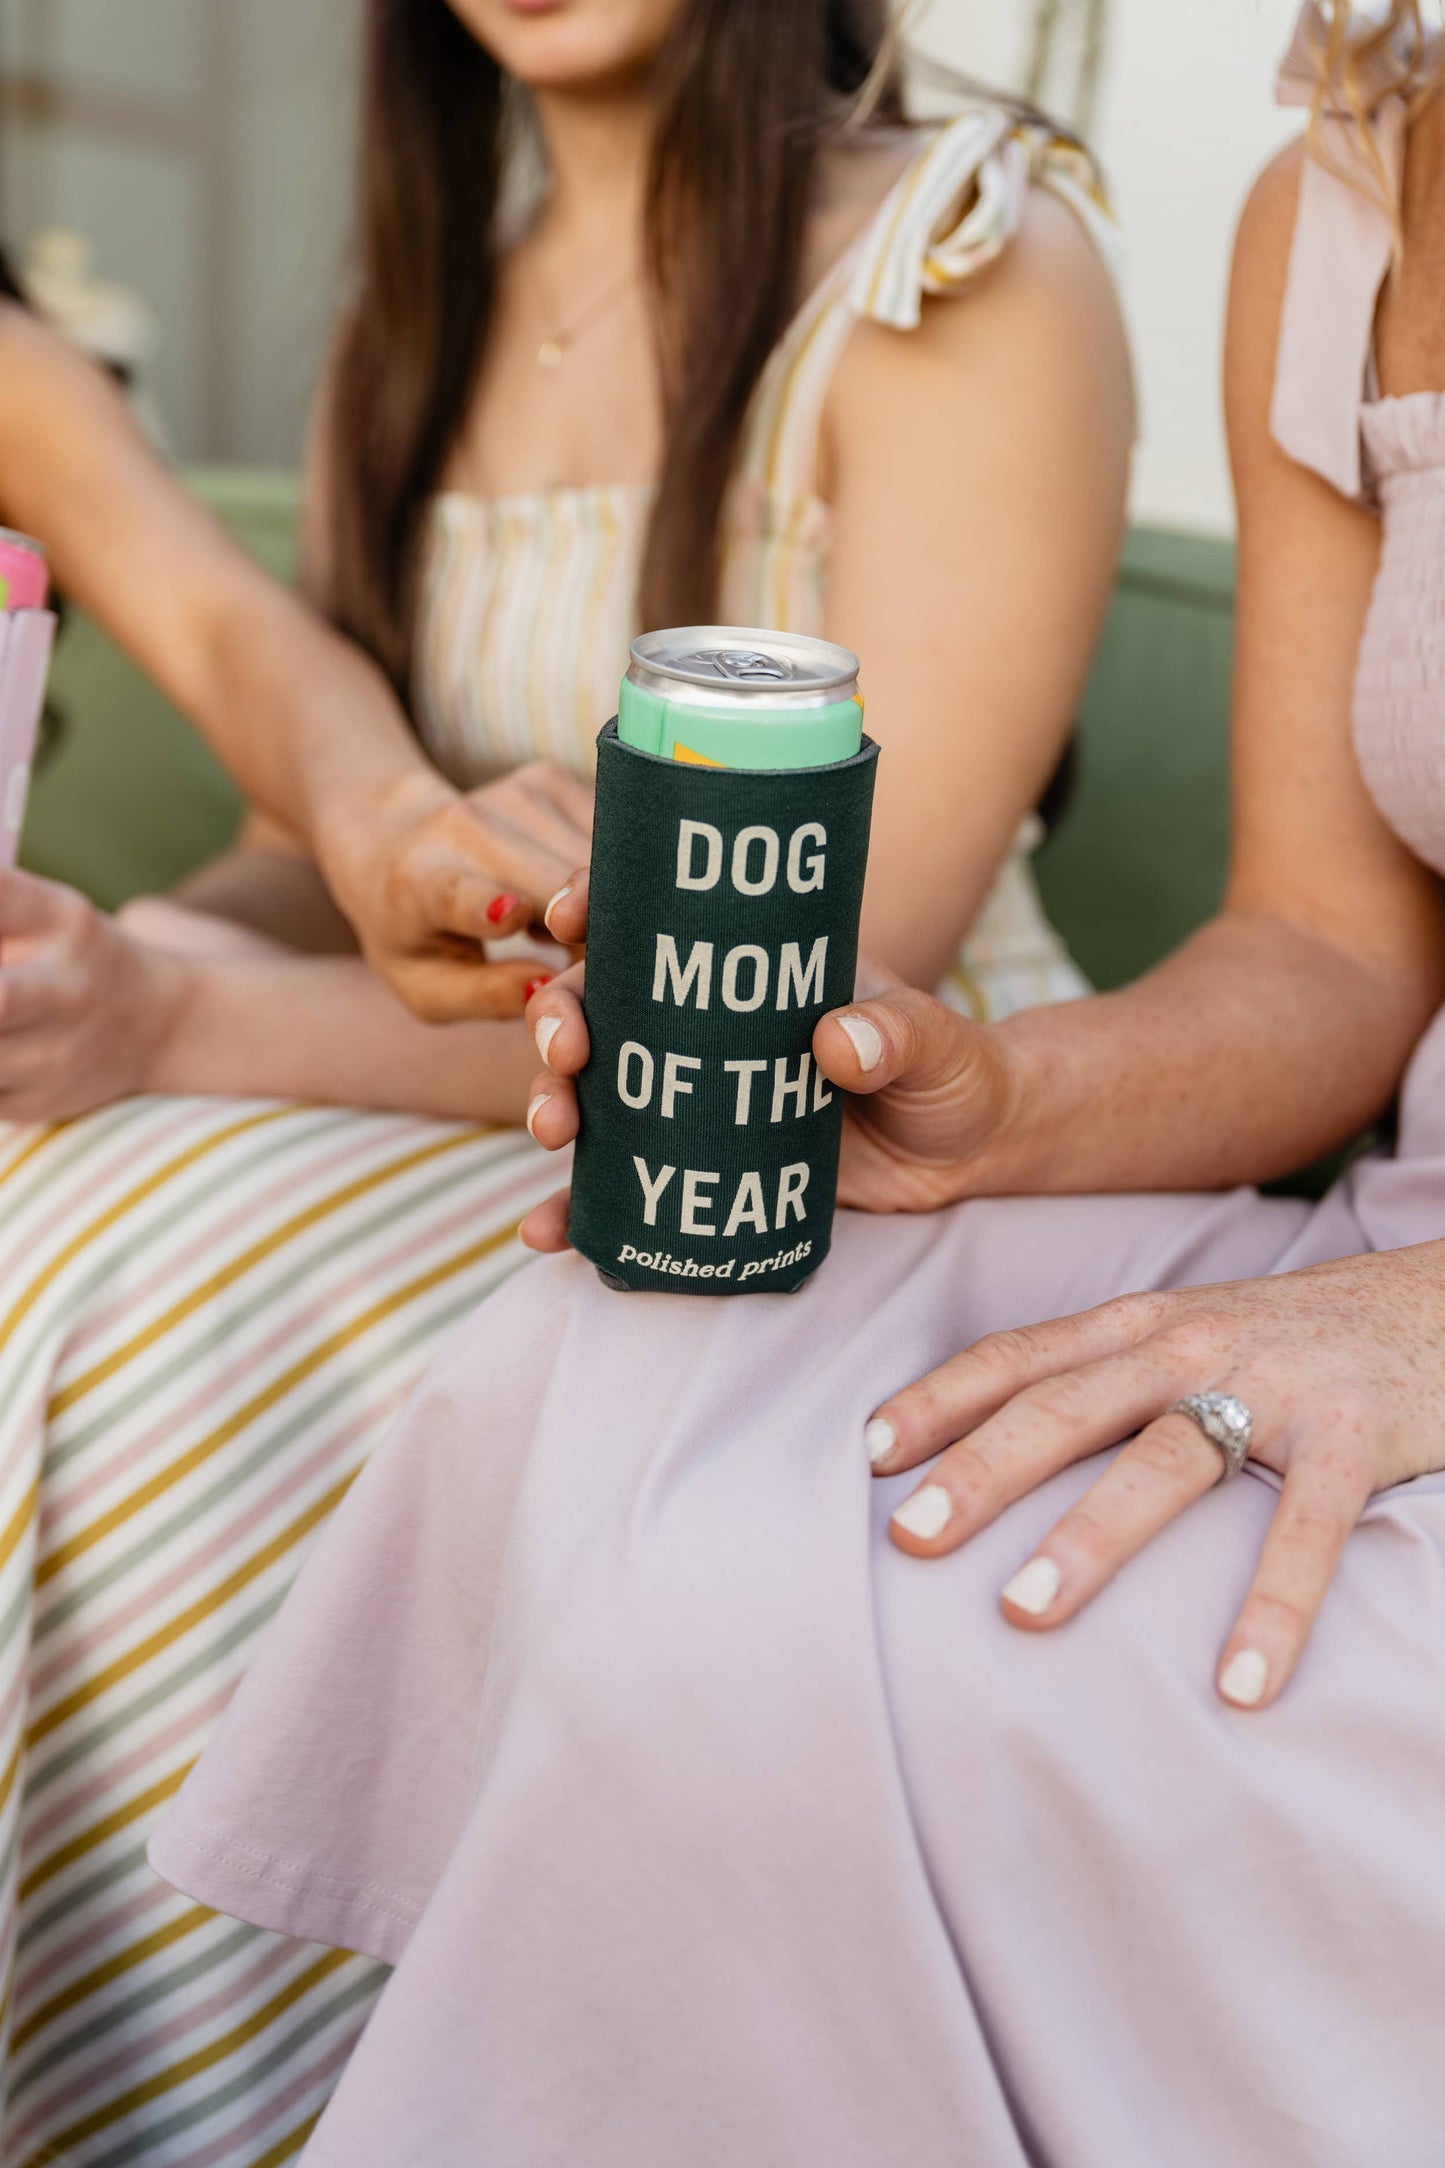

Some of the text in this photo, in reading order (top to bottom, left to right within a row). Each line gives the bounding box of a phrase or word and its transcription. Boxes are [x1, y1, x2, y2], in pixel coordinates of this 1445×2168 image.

[675, 818, 828, 896] DOG
[651, 933, 829, 1013] MOM
[617, 1040, 702, 1119] OF
[632, 1155, 810, 1237] YEAR
[617, 1240, 813, 1282] polished prints
